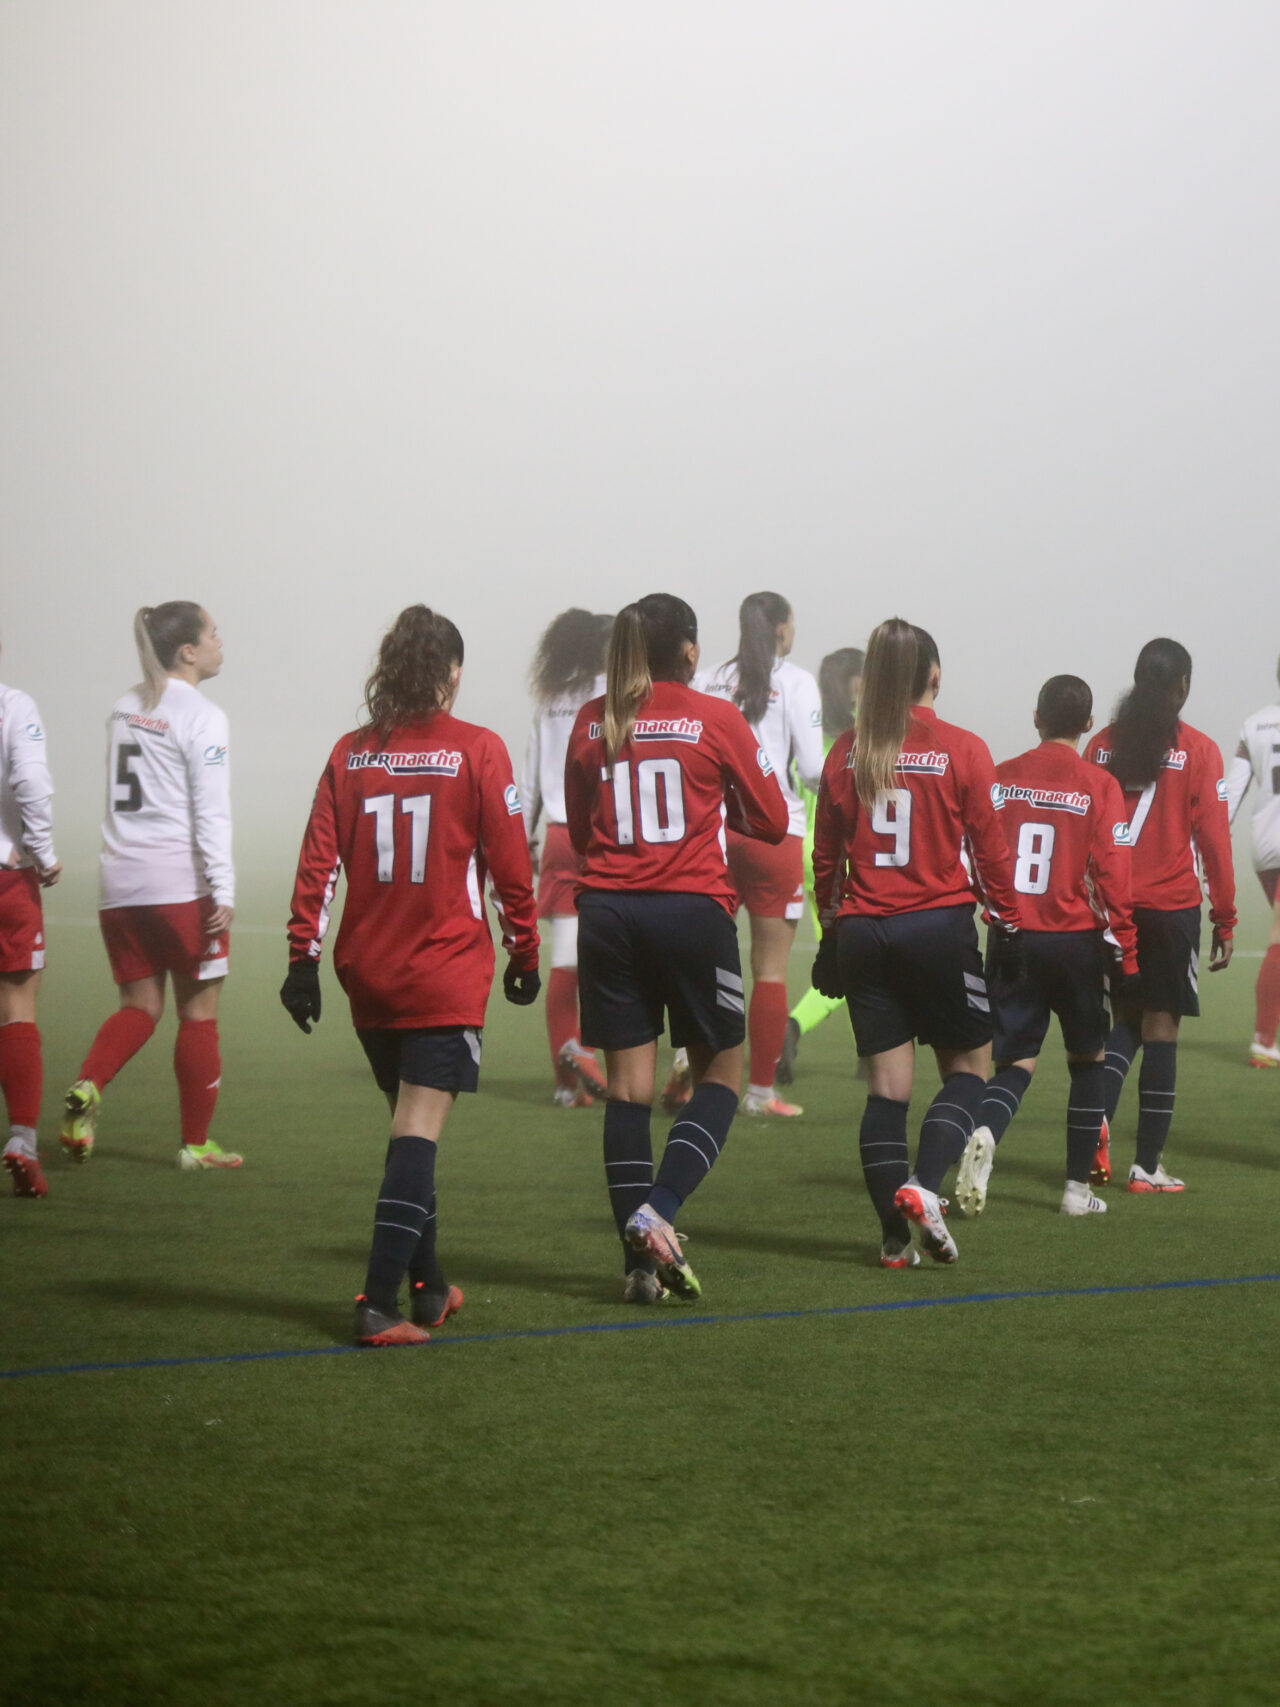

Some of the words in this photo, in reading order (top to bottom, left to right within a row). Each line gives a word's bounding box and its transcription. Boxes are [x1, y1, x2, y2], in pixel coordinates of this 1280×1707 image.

[113, 743, 142, 812] 5
[347, 750, 462, 775] Intermarché
[601, 757, 686, 845] 10
[871, 787, 912, 867] 9
[1124, 780, 1157, 847] 7
[363, 793, 431, 884] 11
[1014, 822, 1055, 895] 8
